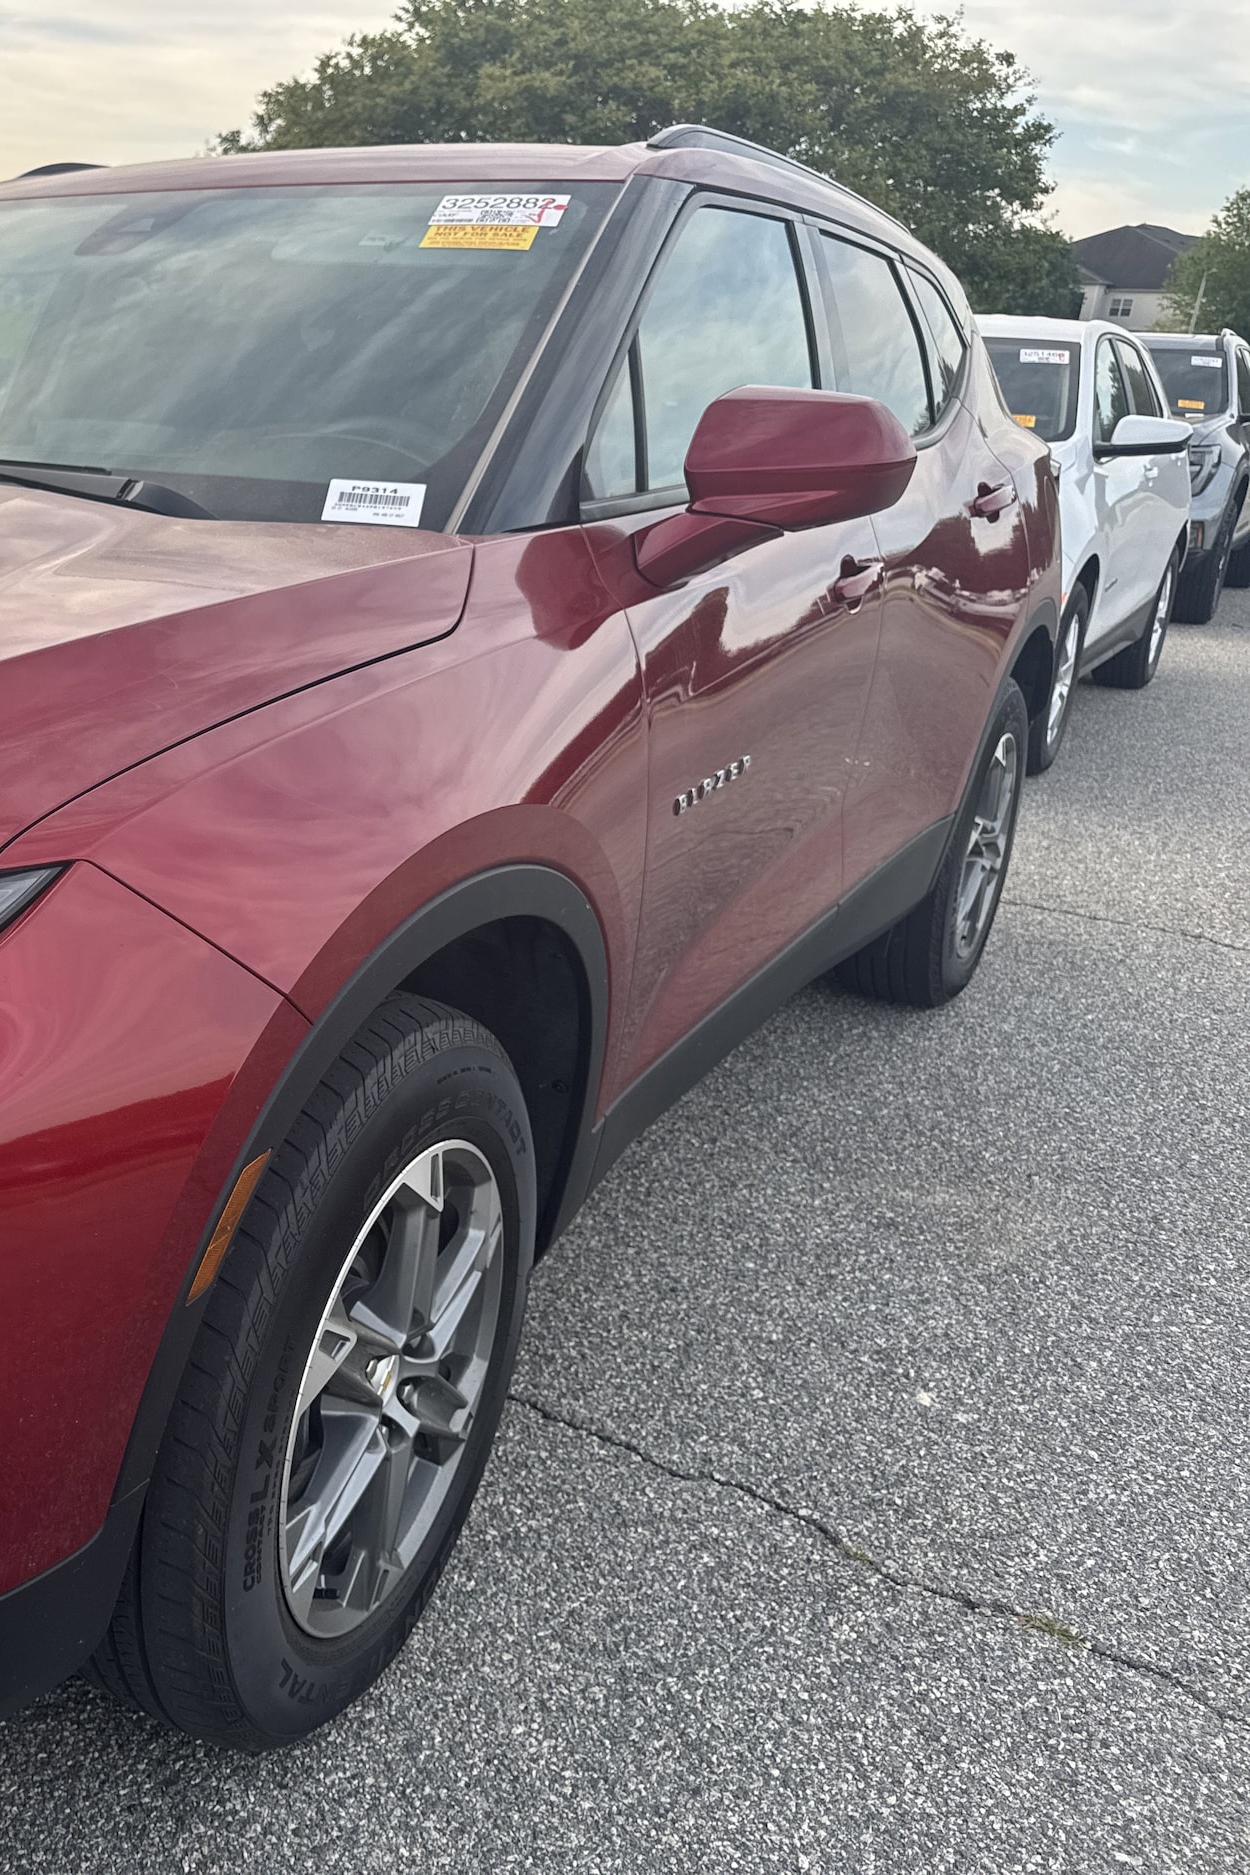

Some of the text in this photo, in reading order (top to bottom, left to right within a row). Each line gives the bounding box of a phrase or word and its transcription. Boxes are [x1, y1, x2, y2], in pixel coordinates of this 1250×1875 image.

[442, 197, 556, 210] 3252882
[471, 226, 531, 234] VEHICLE
[351, 485, 399, 495] P9314
[673, 754, 751, 816] BLAZER
